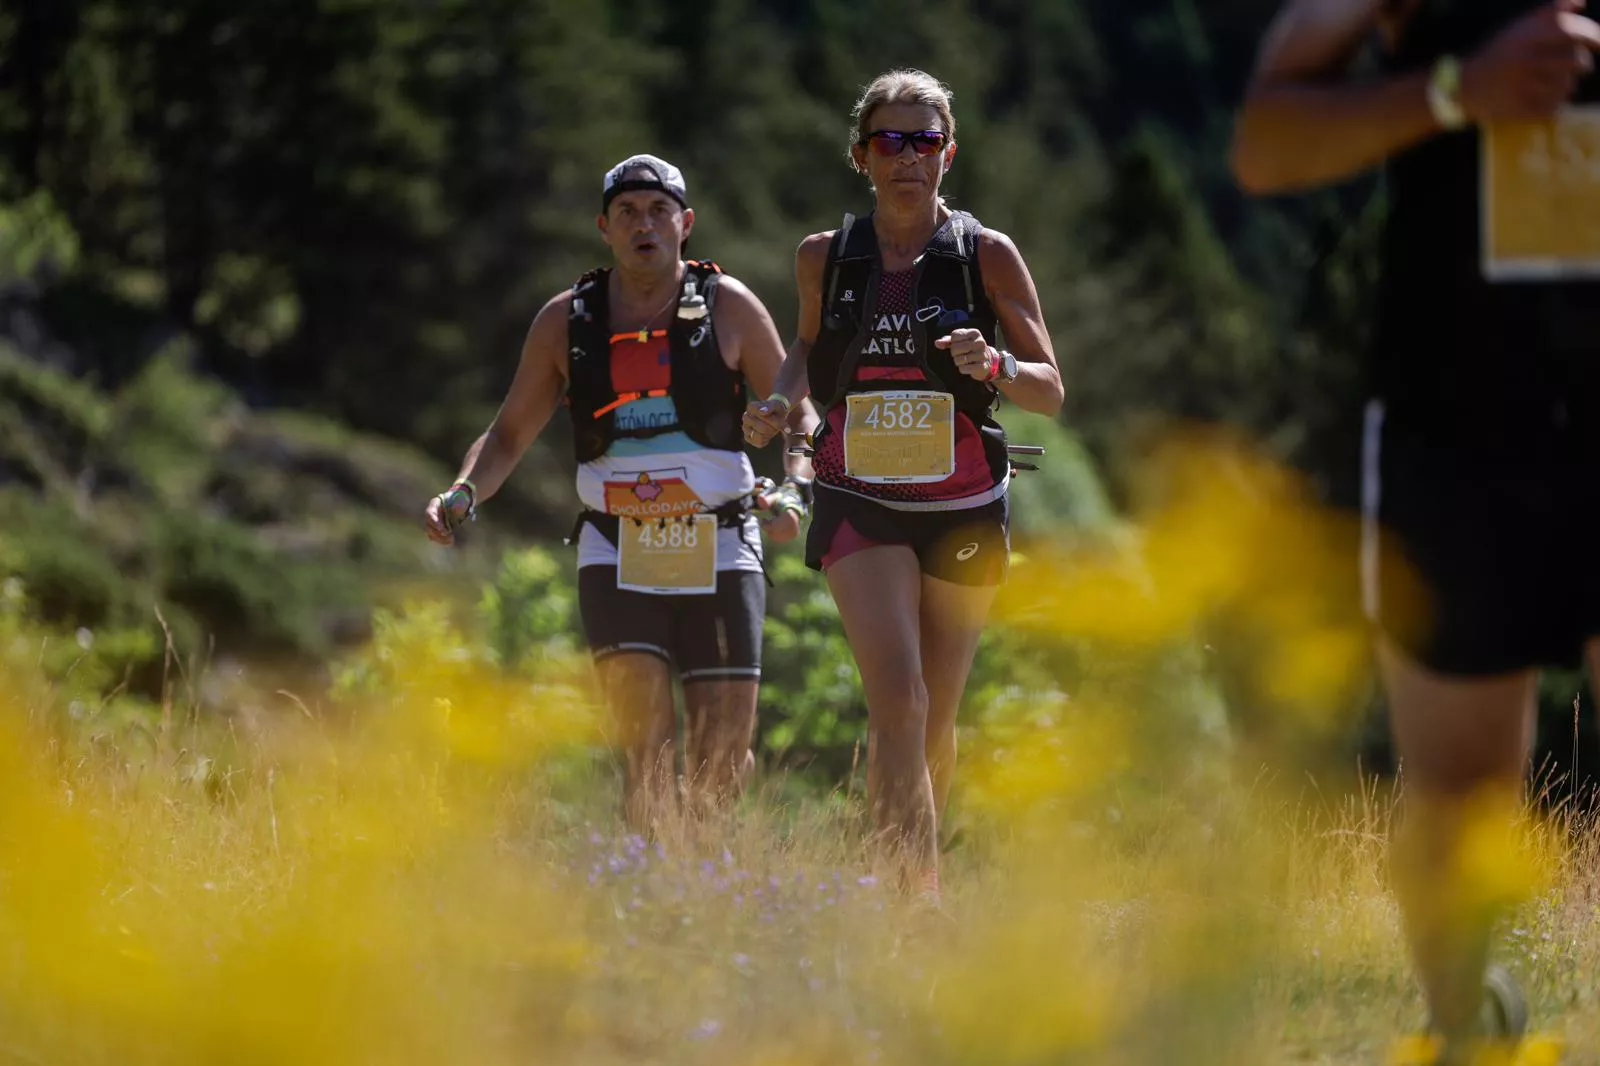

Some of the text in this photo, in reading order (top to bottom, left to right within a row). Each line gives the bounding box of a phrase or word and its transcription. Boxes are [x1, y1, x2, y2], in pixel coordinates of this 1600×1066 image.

[871, 313, 912, 332] AV
[615, 408, 646, 430] TÓN
[864, 401, 932, 429] 4582
[638, 523, 698, 548] 4388
